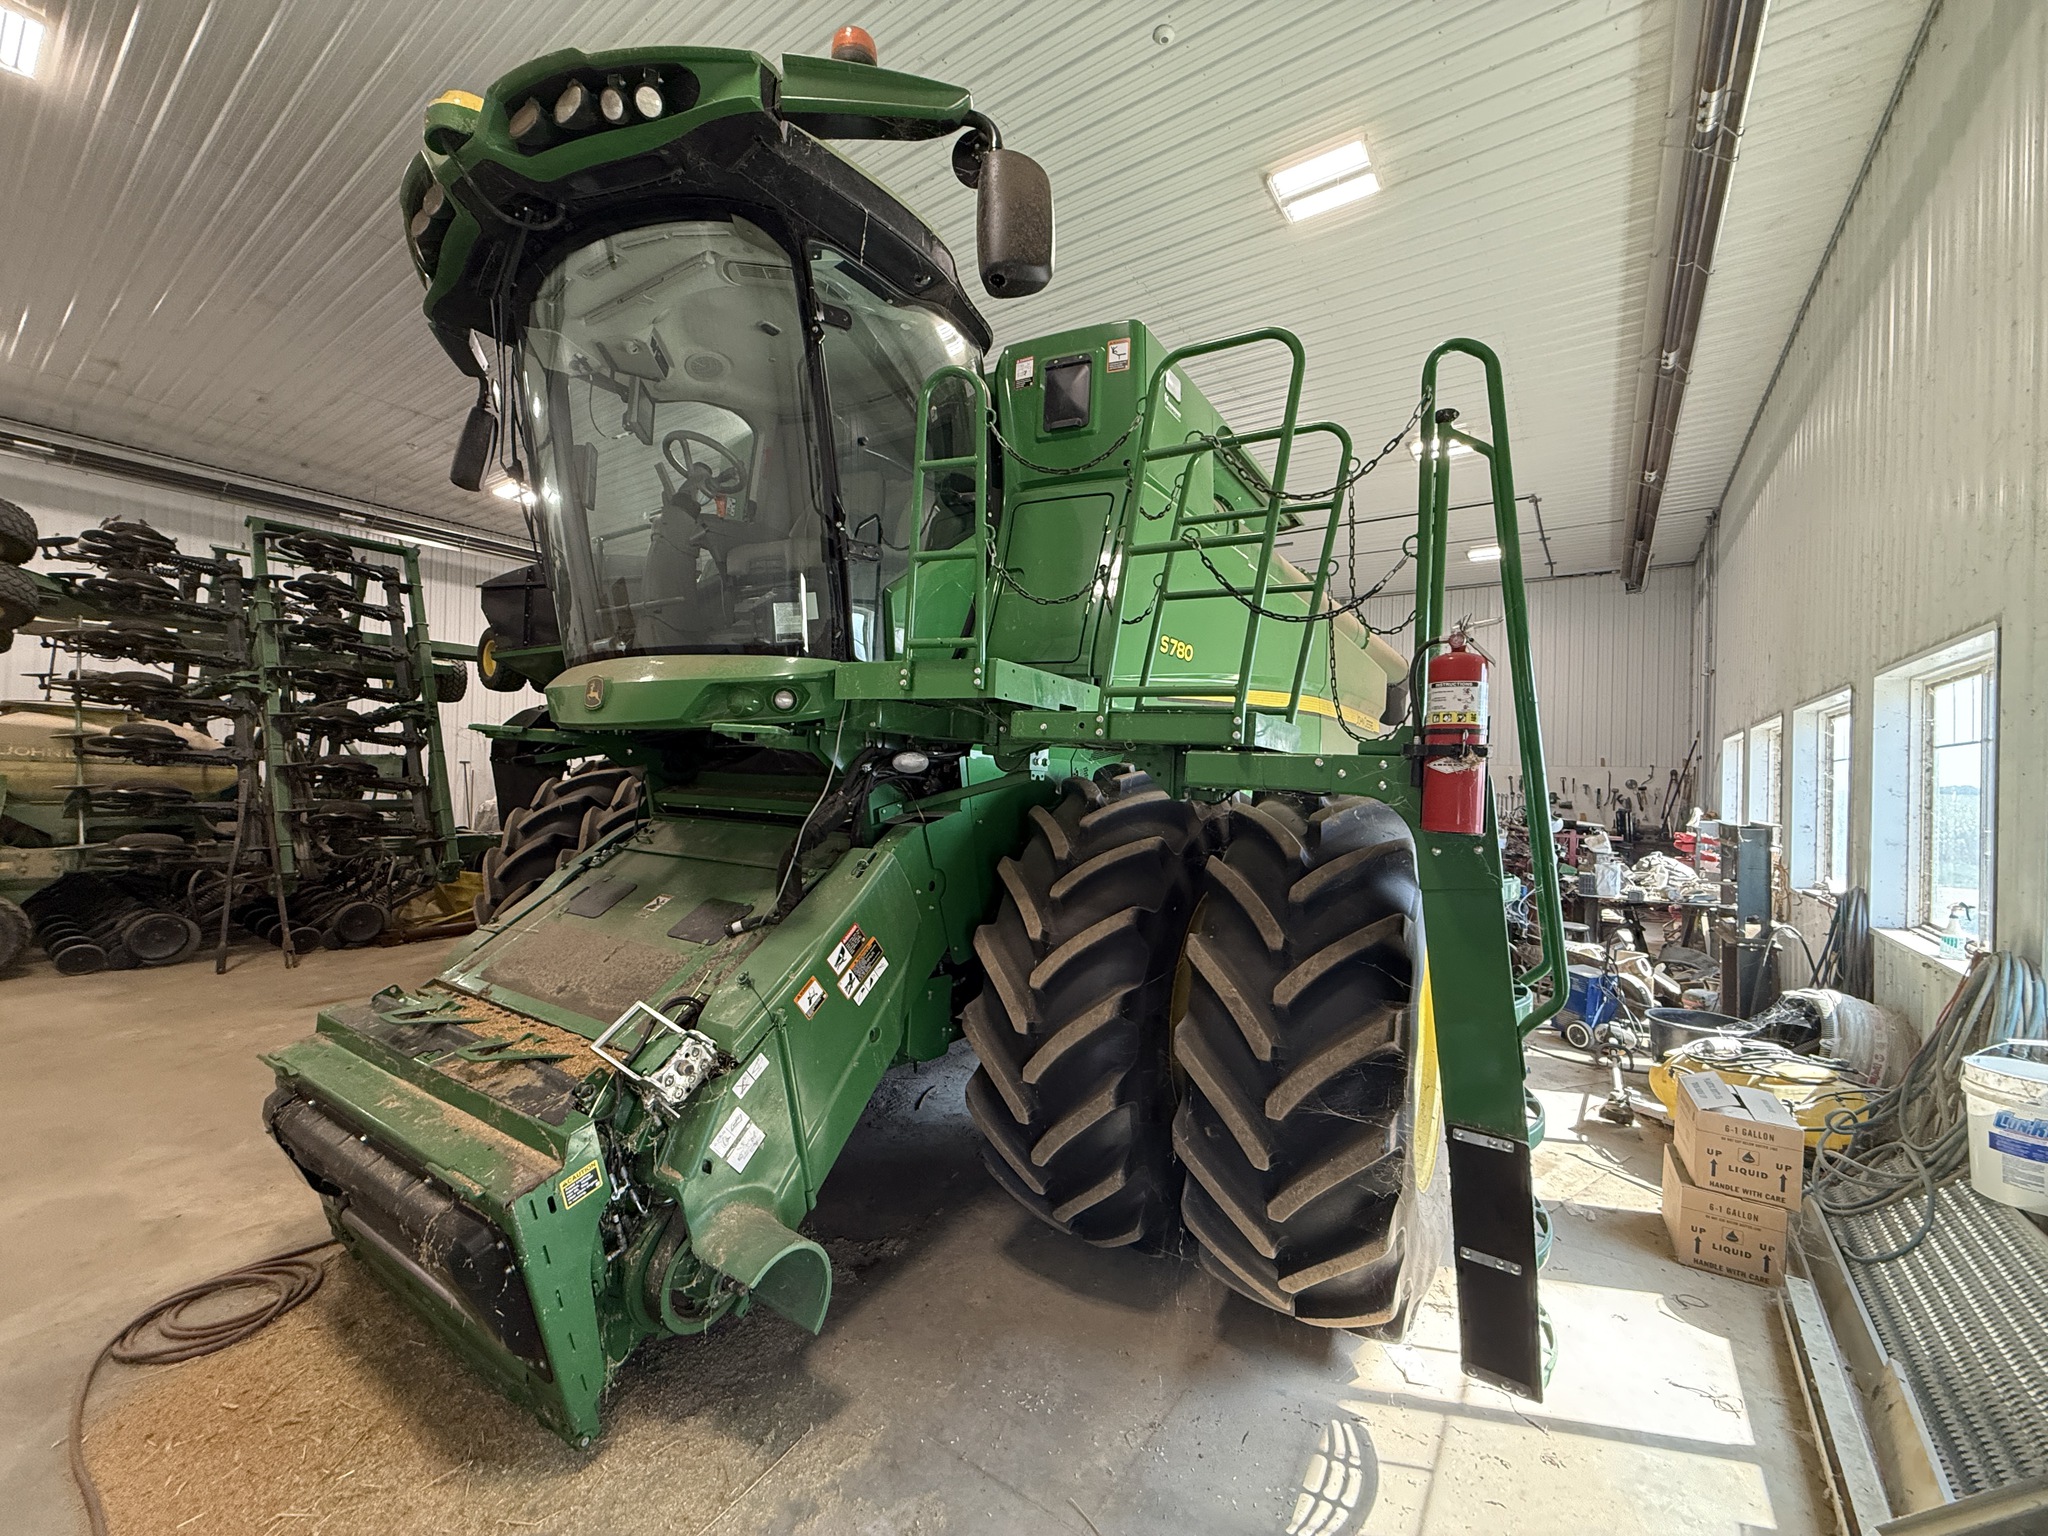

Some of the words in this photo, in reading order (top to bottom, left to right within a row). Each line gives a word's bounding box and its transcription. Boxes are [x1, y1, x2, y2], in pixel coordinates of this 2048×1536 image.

[1160, 634, 1194, 662] S780
[1724, 1124, 1738, 1135] 6-1
[1742, 1127, 1775, 1142] GALLON
[1706, 1148, 1722, 1157] UP
[567, 1162, 596, 1184] CAUTION
[1728, 1164, 1769, 1180] LIQUID
[1775, 1163, 1792, 1172] UP
[1709, 1180, 1740, 1193] HANDLE
[1742, 1188, 1763, 1199] WITH
[1765, 1193, 1786, 1204] CARE
[1709, 1203, 1723, 1213] 6-1
[1726, 1206, 1759, 1222] GALLON
[1690, 1225, 1706, 1234] UP
[1712, 1242, 1752, 1259] LIQUID
[1759, 1243, 1776, 1253] UP
[1693, 1257, 1724, 1272] HANDLE
[1726, 1266, 1747, 1279] WITH
[1748, 1273, 1770, 1285] CARE
